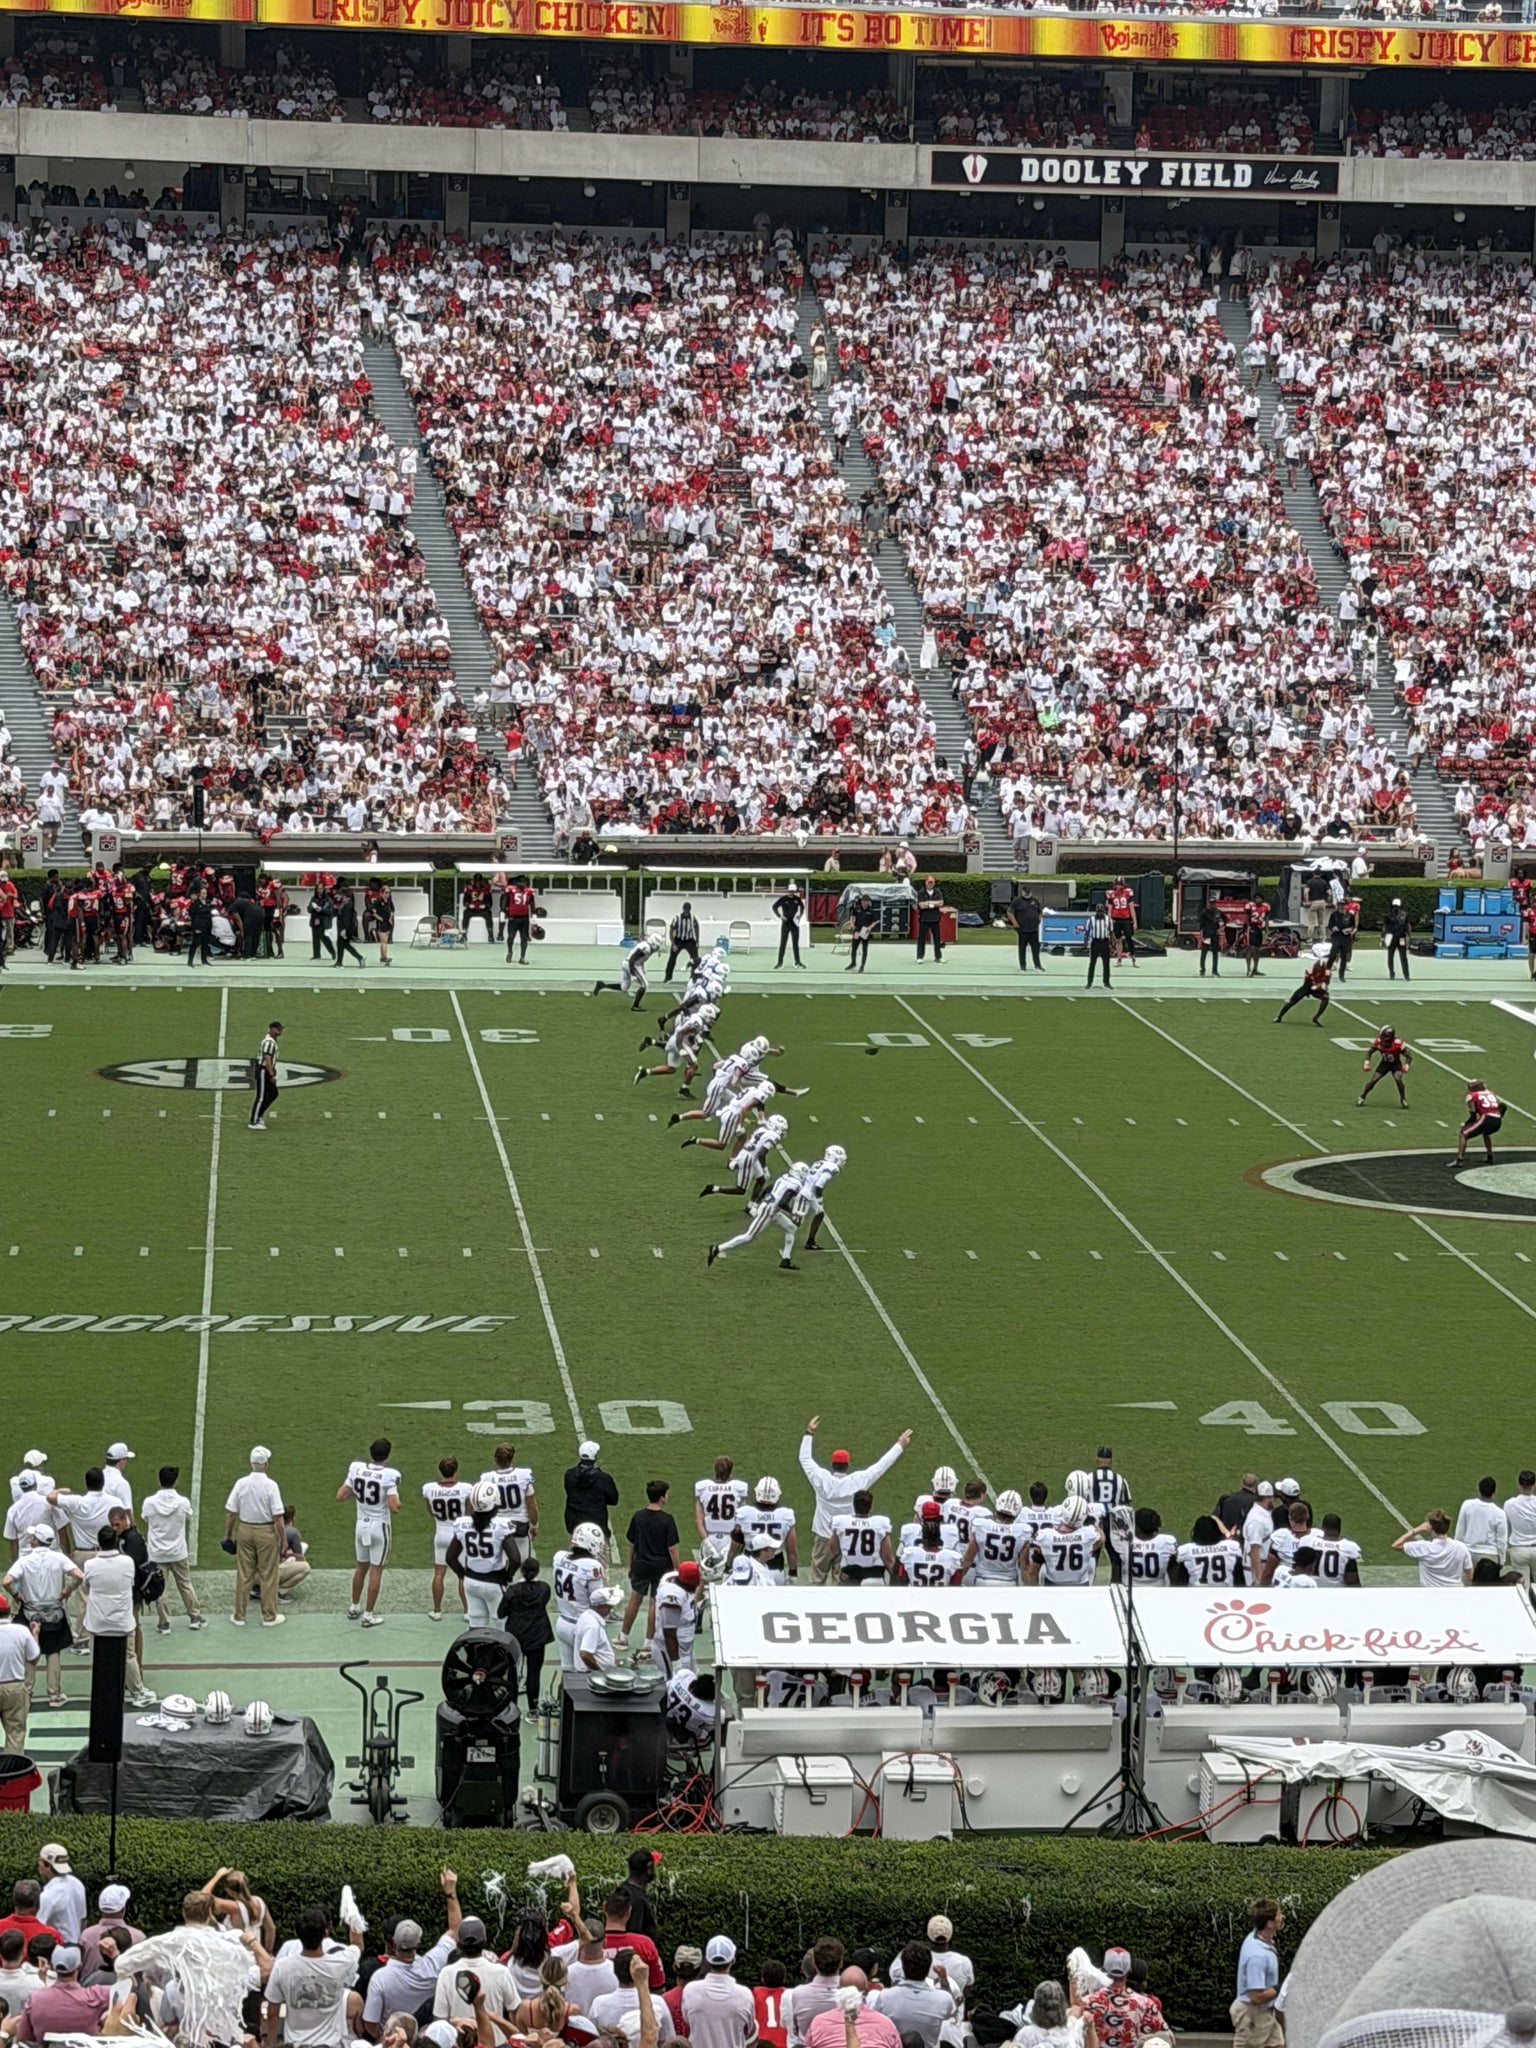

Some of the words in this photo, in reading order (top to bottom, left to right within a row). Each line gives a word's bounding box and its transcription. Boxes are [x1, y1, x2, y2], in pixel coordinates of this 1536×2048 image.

[436, 0, 523, 28] JUICY
[800, 12, 854, 43] IT'S
[863, 14, 900, 44] BO
[1100, 24, 1179, 50] Bojangles
[1290, 28, 1400, 62] CRISPY,
[1409, 31, 1496, 62] JUICY
[1021, 157, 1149, 185] DOOLEY
[1161, 162, 1253, 187] FIELD
[514, 892, 527, 905] 51
[354, 1478, 381, 1505] 93
[432, 1498, 462, 1521] 98
[706, 1494, 736, 1520] 46
[465, 1532, 494, 1558] 65
[845, 1529, 876, 1556] 78
[984, 1534, 1016, 1562] 53
[1053, 1544, 1083, 1571] 76
[1195, 1555, 1227, 1584] 79
[554, 1568, 576, 1600] 64
[913, 1563, 945, 1586] 52
[762, 1611, 1071, 1644] GEORGIA
[1204, 1608, 1485, 1656] Chick-fil-A
[765, 1996, 778, 2028] 1
